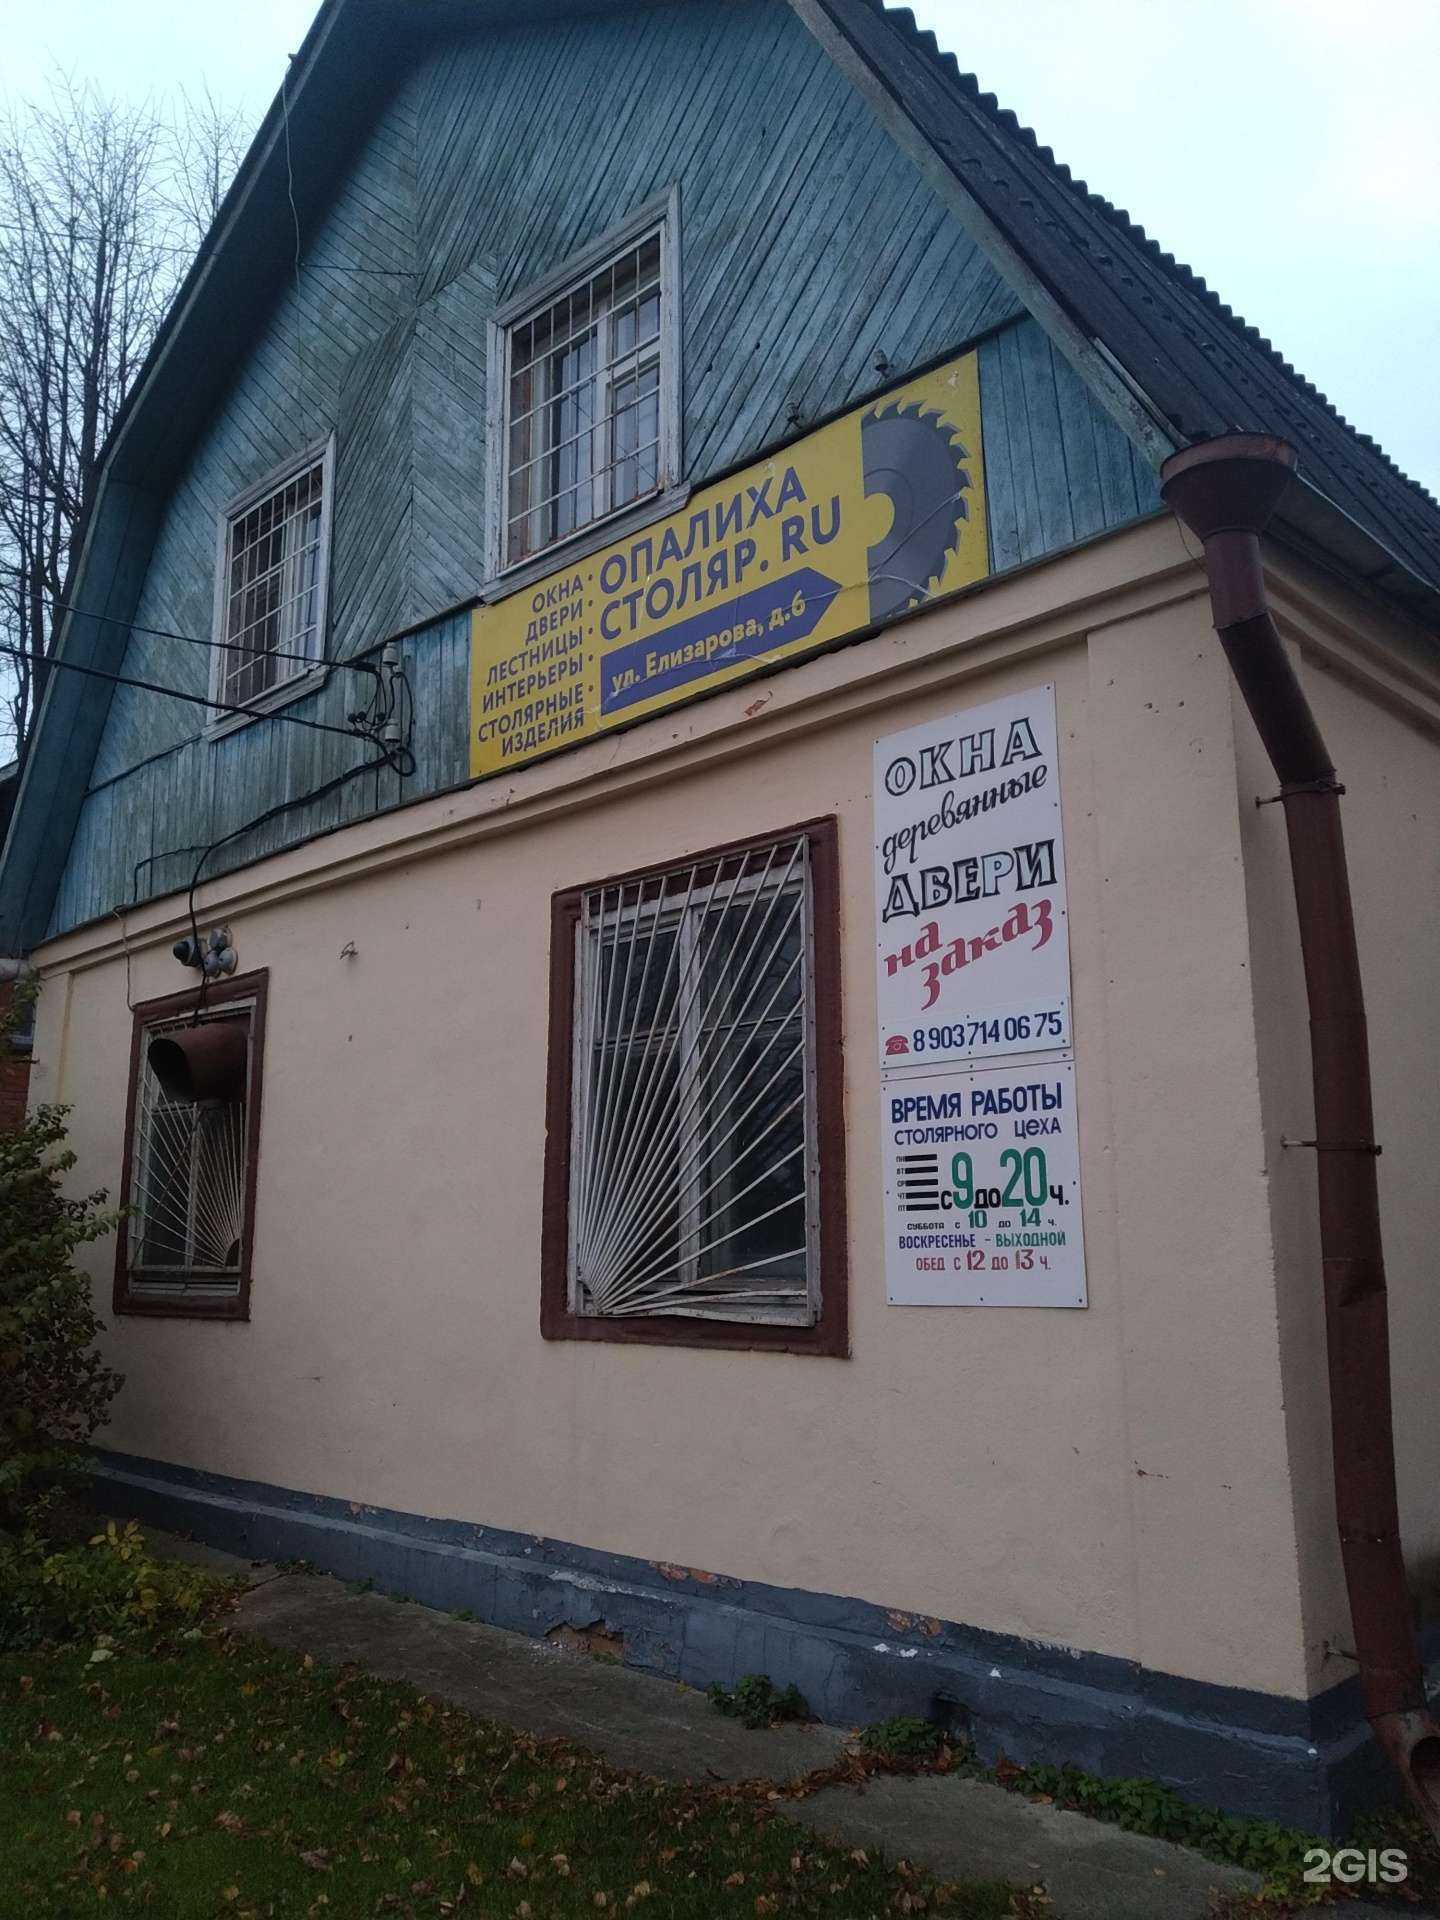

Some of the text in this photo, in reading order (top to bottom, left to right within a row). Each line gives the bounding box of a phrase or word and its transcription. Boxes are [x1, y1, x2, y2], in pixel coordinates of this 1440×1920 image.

[600, 466, 807, 594] ОПАЛИХА
[525, 598, 583, 645] ДВЕРИ
[532, 574, 584, 613] ОКНА
[483, 653, 583, 713] ИНТЕРЬЕРЫ
[487, 626, 583, 686] ЛЕСТНИЦЫ
[611, 667, 641, 694] ул.
[646, 617, 764, 677] Елизарова,
[478, 683, 584, 742] СТОЛЯРНЫЕ
[502, 707, 584, 757] ИЗДЕЛИЯ
[885, 717, 1042, 796] ОКНА
[882, 764, 1048, 875] деревянные
[882, 839, 1058, 923] ДВЕРИ
[884, 921, 943, 977] на
[921, 899, 1053, 1011] заказ
[891, 1082, 1062, 1124] ВРЕМЯ РАБОТЫ
[894, 1122, 998, 1146] СТОЛЯРНОГО
[951, 1151, 974, 1209] 9
[1000, 1146, 1049, 1208] 20
[899, 1234, 976, 1249] ВОСКРЕСЕНЬЕ
[995, 1230, 1066, 1247] ВЫХОДНОЙ
[968, 1210, 988, 1228] 10
[1019, 1208, 1041, 1227] 14
[916, 1257, 945, 1271] ОБЕД
[966, 1249, 986, 1271] 12
[1015, 1248, 1034, 1270] 13
